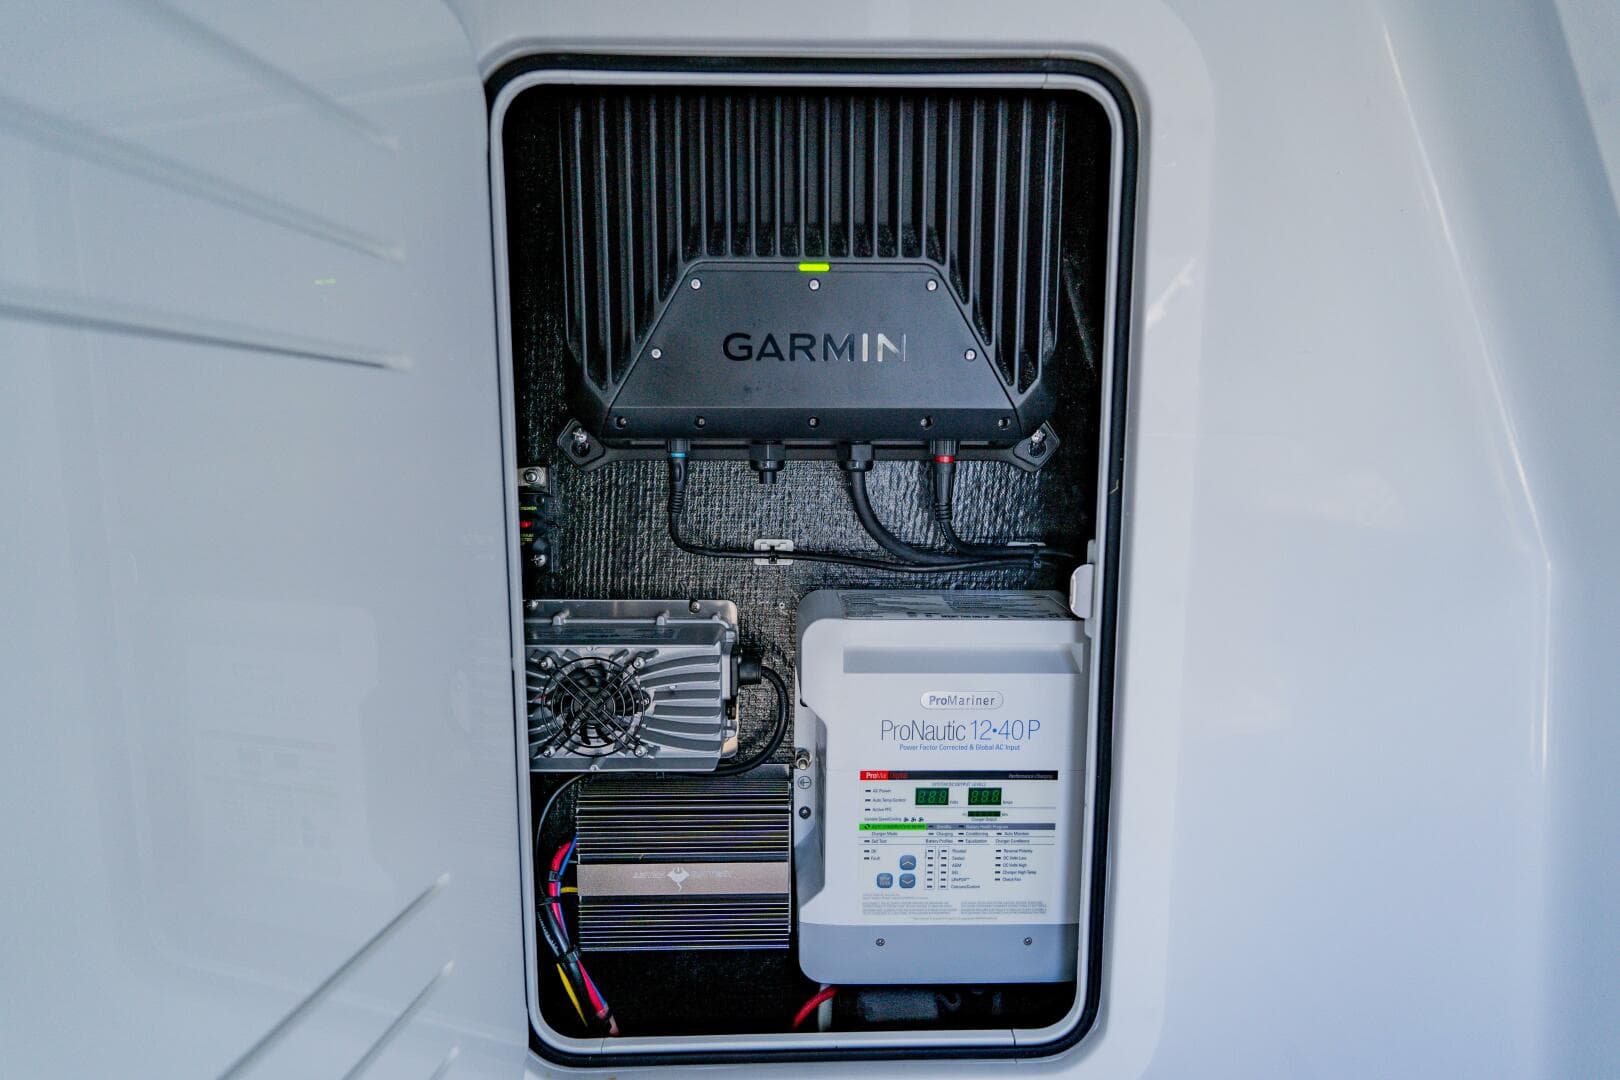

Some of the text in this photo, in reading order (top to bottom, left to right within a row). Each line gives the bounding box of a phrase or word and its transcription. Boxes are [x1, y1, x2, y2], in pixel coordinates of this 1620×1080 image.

[722, 332, 907, 362] GARMIN
[928, 694, 996, 706] ProMariner
[880, 719, 967, 741] ProNautic
[899, 743, 918, 751] Power
[919, 743, 938, 751] Factor
[939, 743, 968, 751] Corrected
[975, 743, 993, 751] Global
[995, 743, 1004, 751] AC
[1006, 743, 1021, 752] Input
